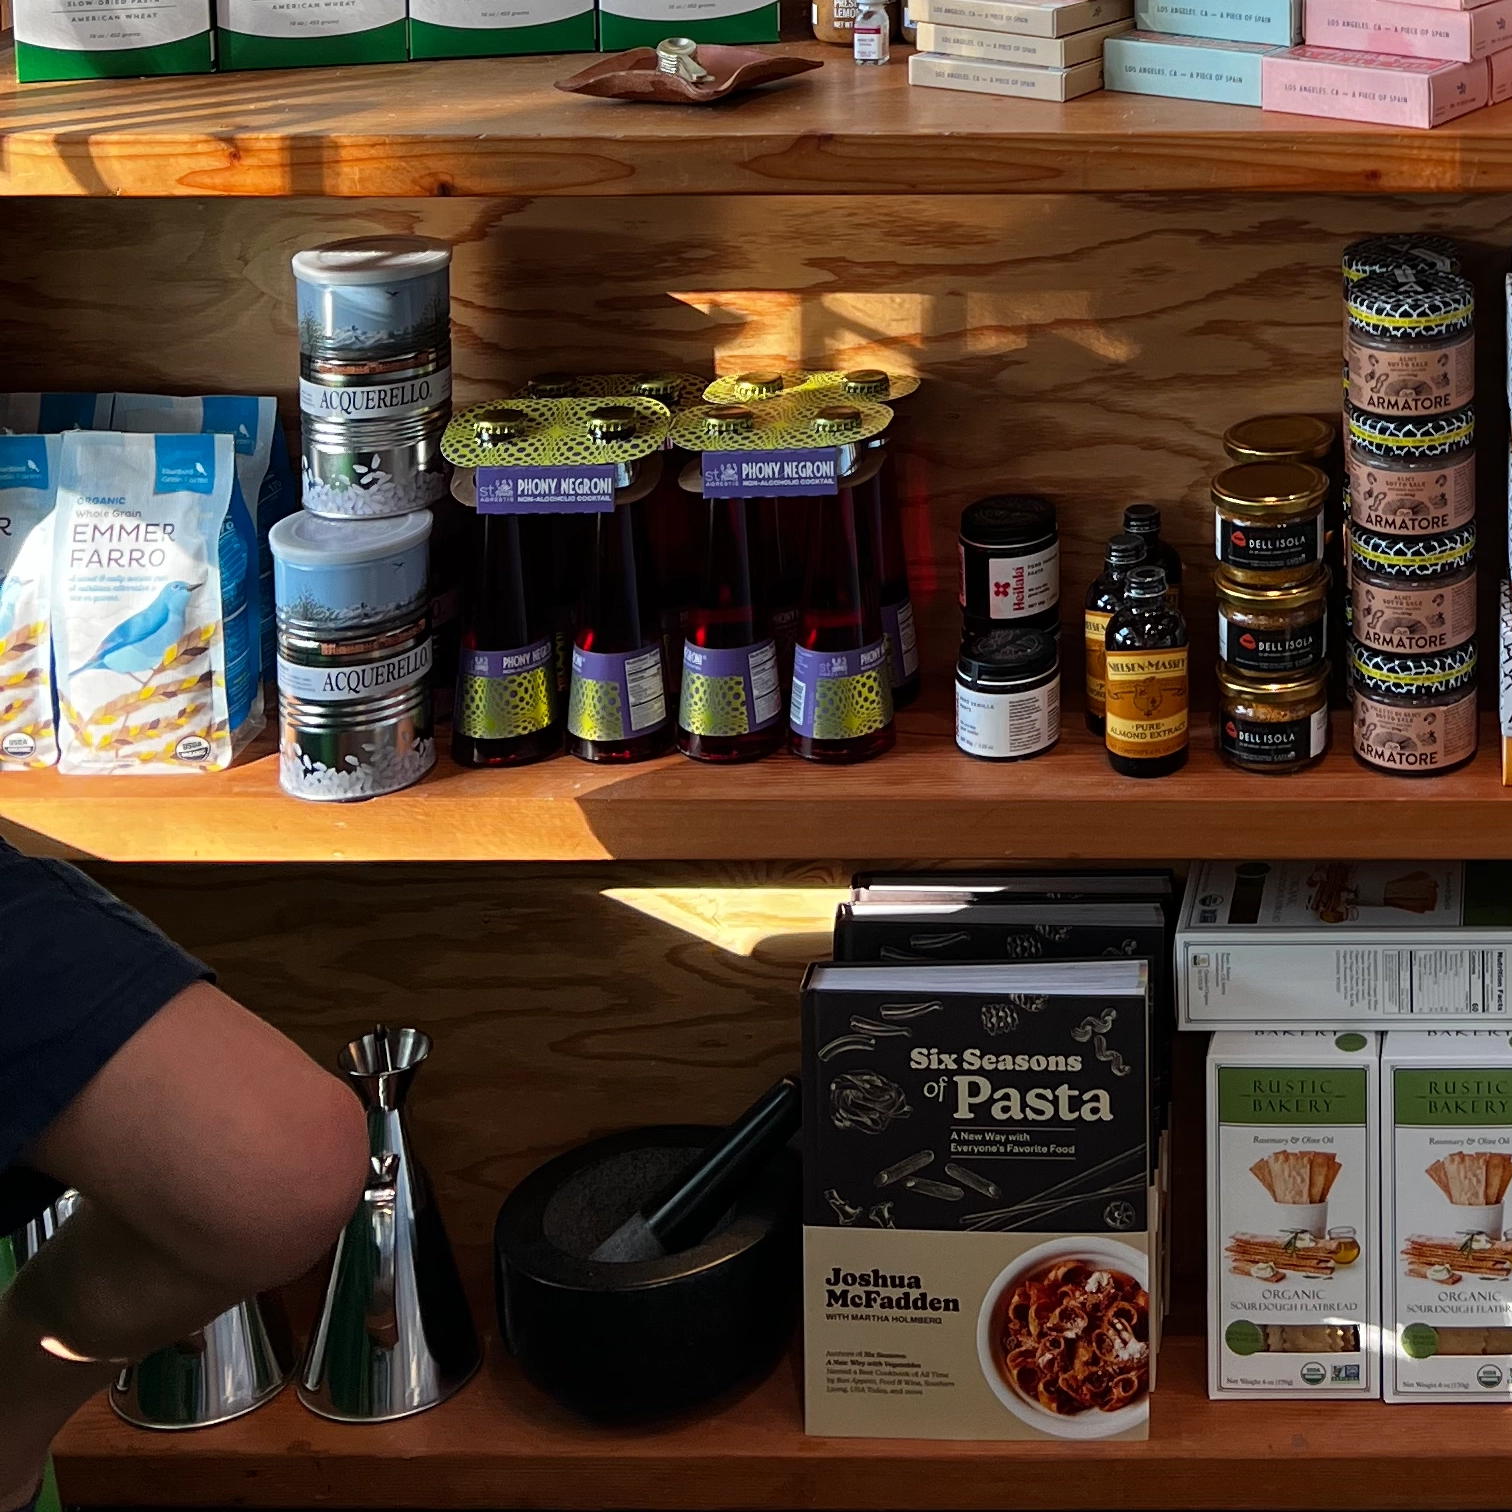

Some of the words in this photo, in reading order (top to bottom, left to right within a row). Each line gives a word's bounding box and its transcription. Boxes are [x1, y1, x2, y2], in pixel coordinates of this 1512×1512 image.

[320, 382, 430, 412] ACQUERELLO
[1366, 394, 1451, 412] ARMATORE
[517, 478, 558, 494] PHONY
[560, 478, 612, 494] NEGRONI
[77, 496, 126, 506] ORGANIC
[75, 508, 106, 519] Whole
[108, 508, 142, 519] Grain
[72, 523, 176, 544] EMMER
[69, 547, 166, 568] FARRO
[1109, 727, 1147, 738] ALMOND
[1149, 721, 1186, 738] EXTRACT
[1135, 722, 1161, 731] PURE
[909, 1048, 959, 1070] Six
[962, 1049, 1082, 1072] Seasons
[1252, 1080, 1334, 1095] RUSTIC
[923, 1078, 948, 1102] of
[952, 1075, 1114, 1123] Pasta
[1252, 1098, 1334, 1115] BAKERY
[951, 1132, 958, 1141] A
[961, 1132, 981, 1141] New
[983, 1132, 1005, 1144] Way
[1007, 1132, 1030, 1141] with
[950, 1144, 1004, 1154] Everyone's
[1007, 1144, 1047, 1154] Favorite
[1049, 1144, 1075, 1154] Food
[825, 1267, 922, 1290] Joshua
[825, 1288, 960, 1313] McFadden
[1261, 1288, 1326, 1301] ORGANIC
